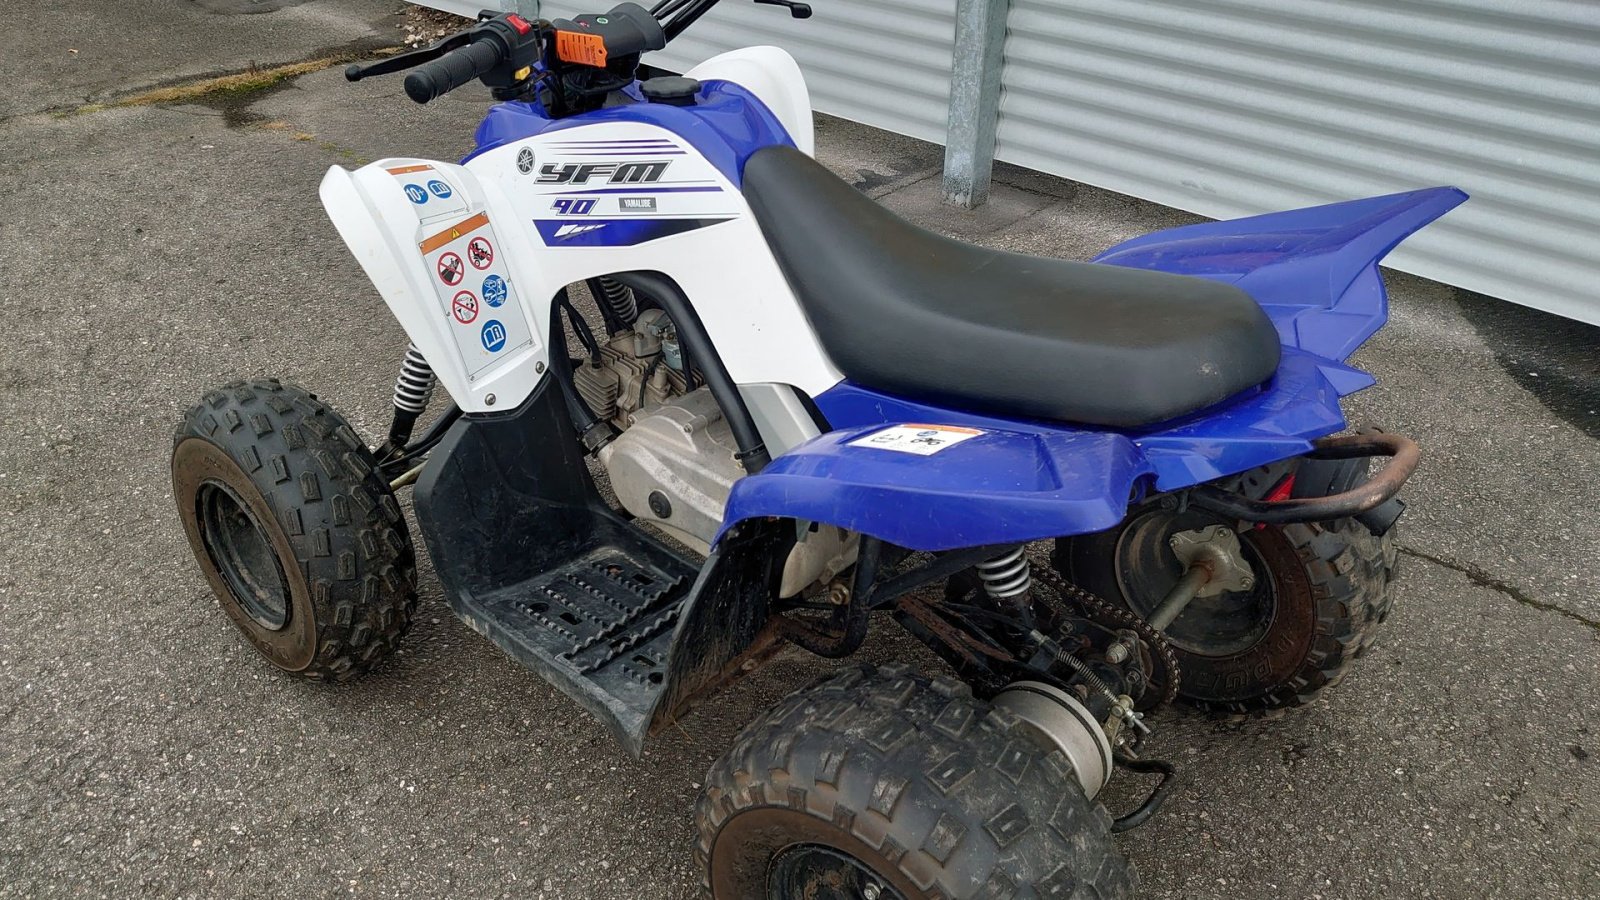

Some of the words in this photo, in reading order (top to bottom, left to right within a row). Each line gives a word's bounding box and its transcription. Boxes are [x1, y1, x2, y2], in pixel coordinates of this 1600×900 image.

[533, 160, 673, 184] YFM
[405, 187, 424, 202] 10+
[551, 197, 600, 216] 90
